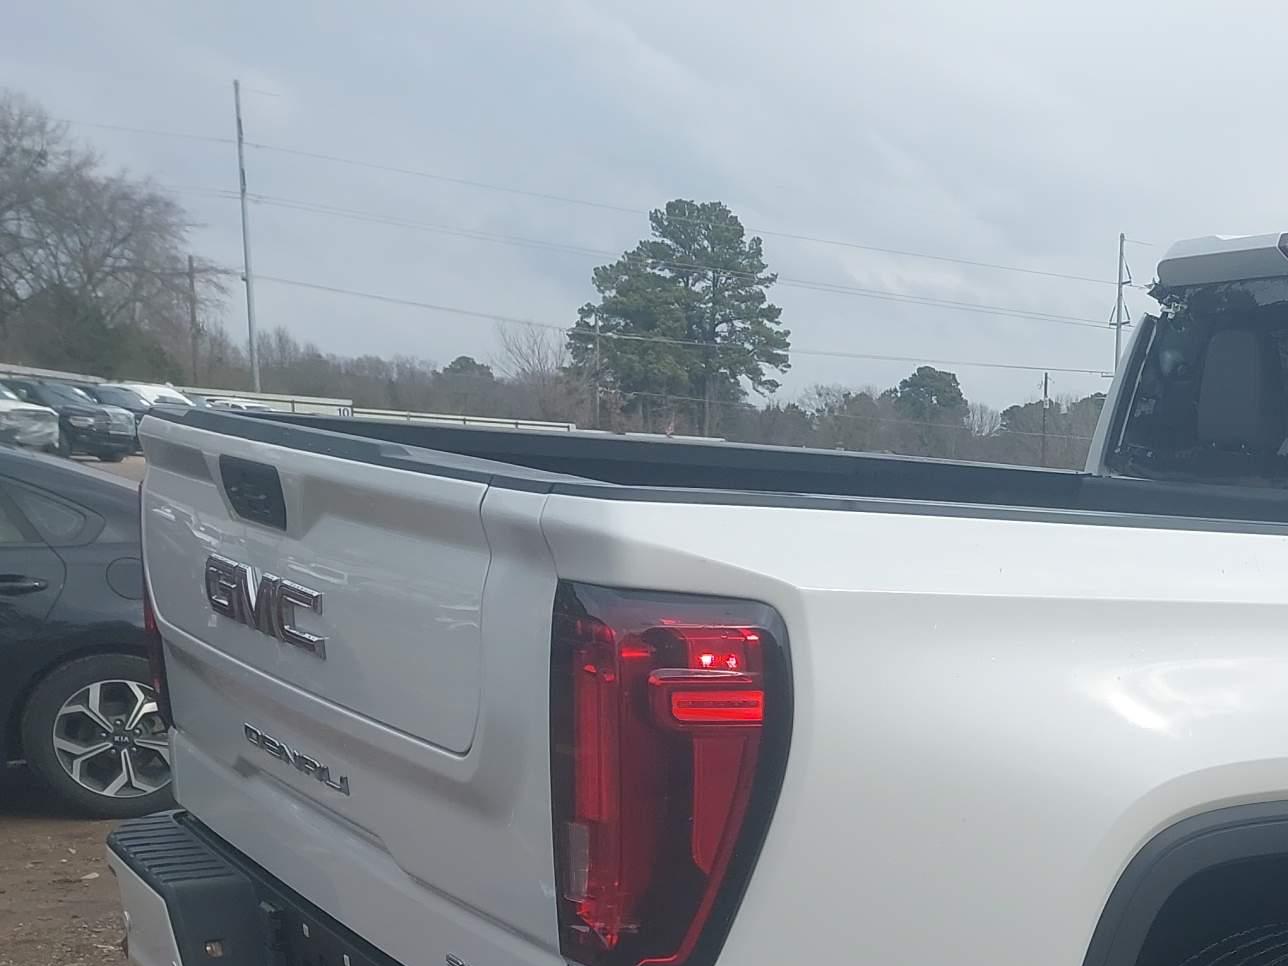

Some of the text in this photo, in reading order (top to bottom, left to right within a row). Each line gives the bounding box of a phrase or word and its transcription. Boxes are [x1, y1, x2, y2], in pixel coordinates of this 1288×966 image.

[205, 552, 327, 661] GMC
[114, 735, 129, 743] KIA
[244, 722, 350, 797] DENALI
